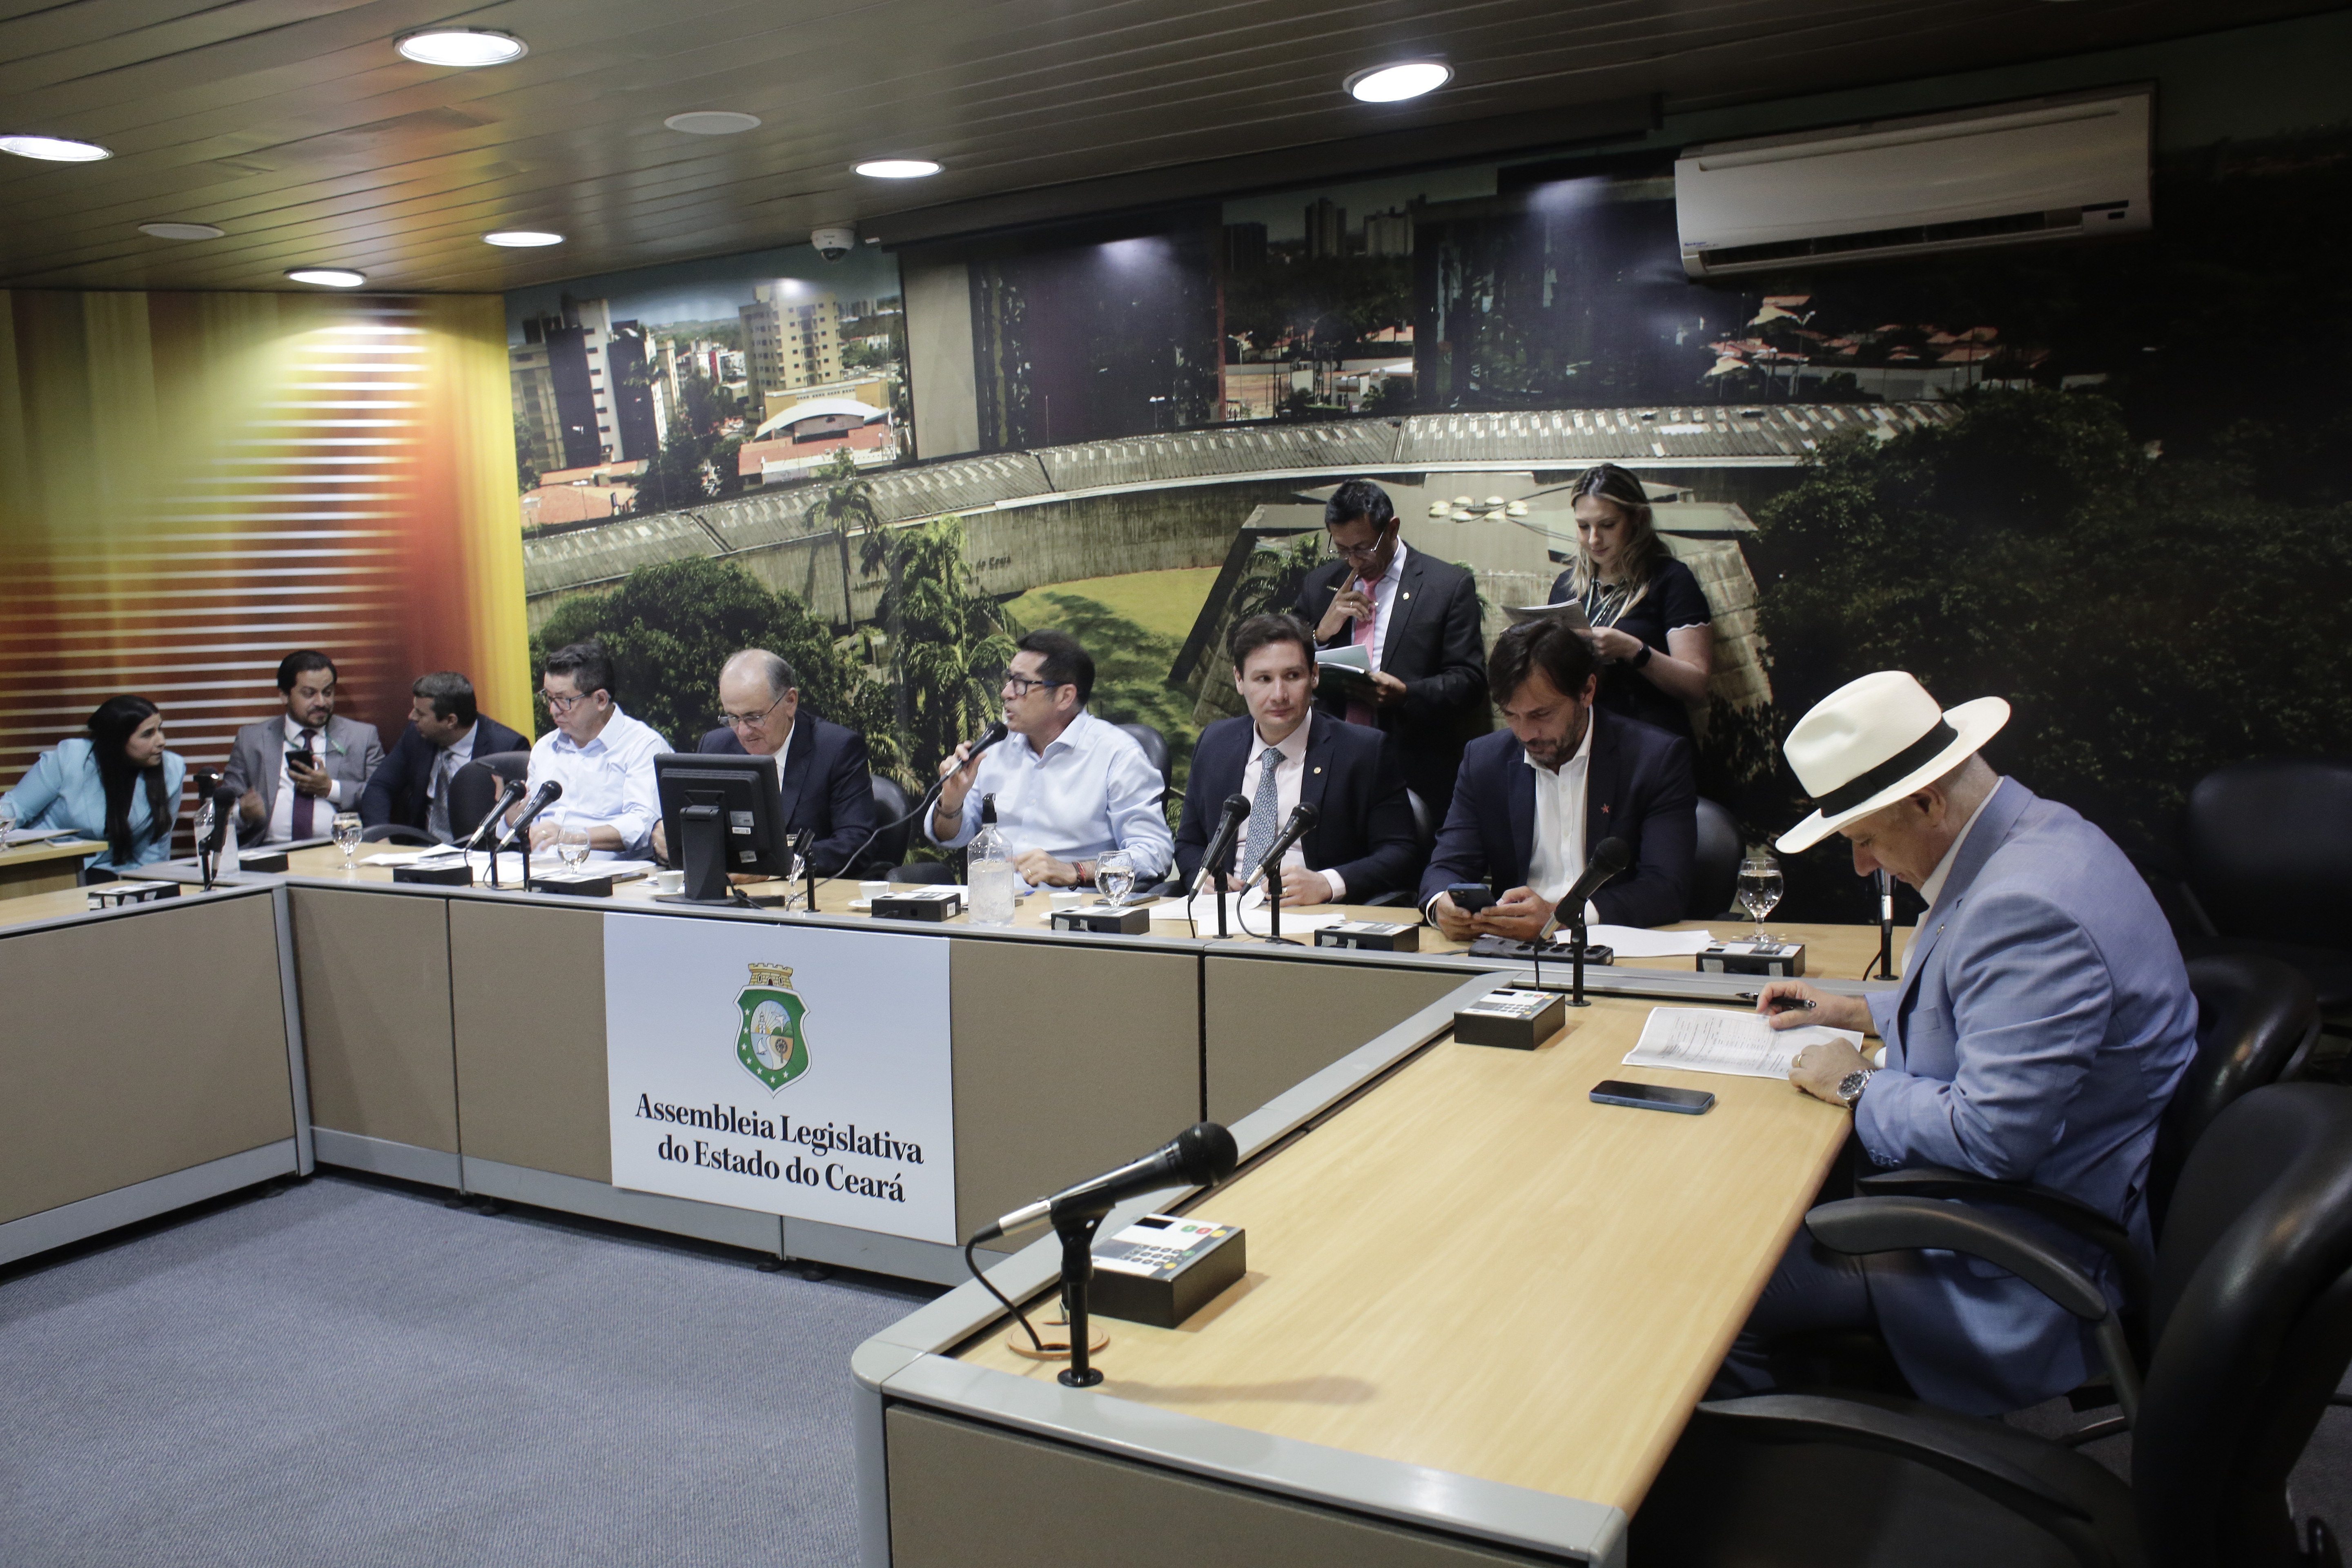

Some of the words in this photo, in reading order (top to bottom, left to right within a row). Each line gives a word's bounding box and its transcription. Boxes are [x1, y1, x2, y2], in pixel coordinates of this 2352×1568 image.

[635, 1093, 777, 1140] Assembleia
[780, 1115, 924, 1165] Legislativa
[658, 1134, 689, 1163] do
[693, 1140, 780, 1180] Estado
[785, 1156, 820, 1187] do
[825, 1163, 906, 1203] Ceará
